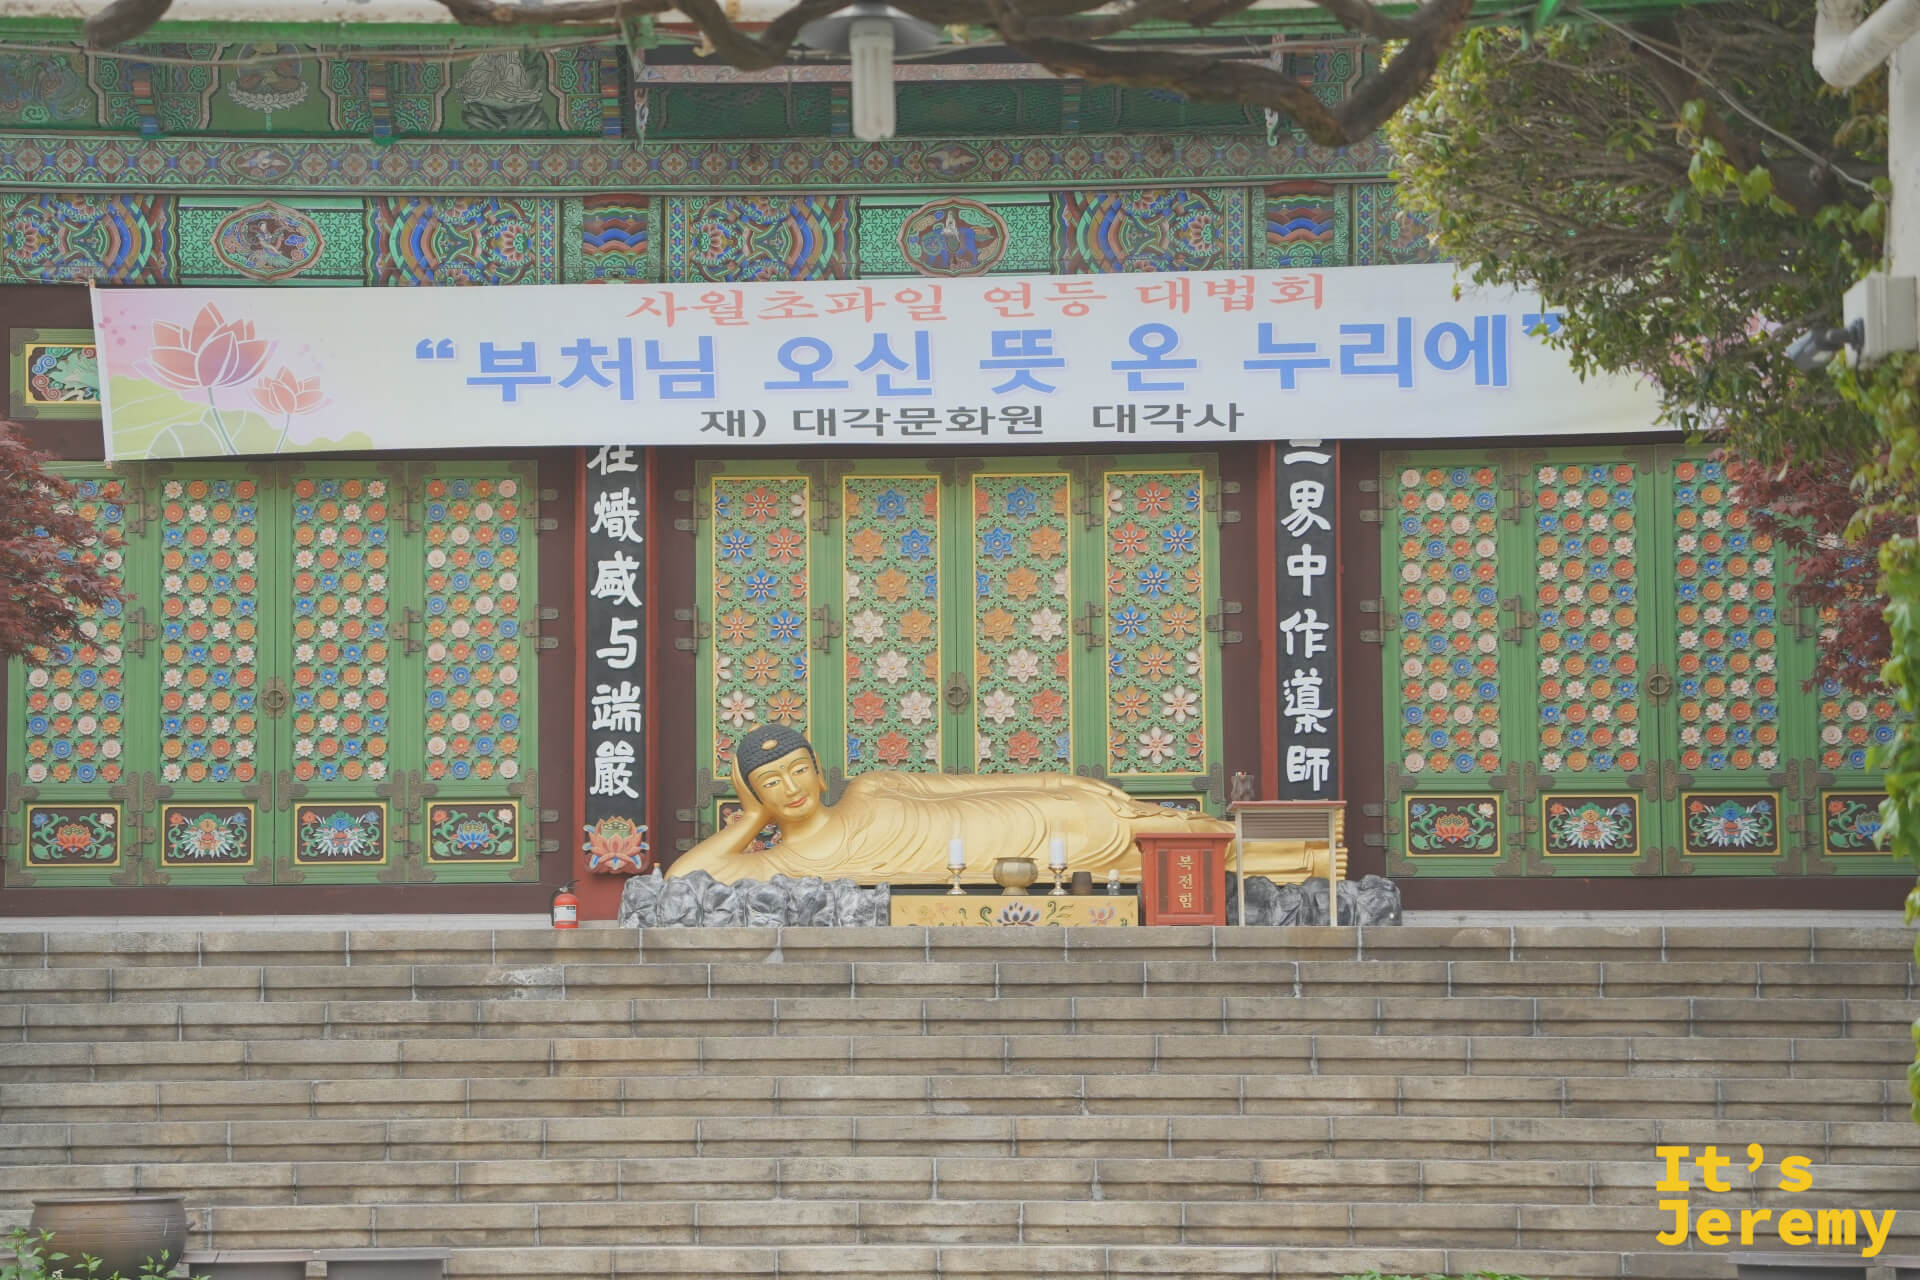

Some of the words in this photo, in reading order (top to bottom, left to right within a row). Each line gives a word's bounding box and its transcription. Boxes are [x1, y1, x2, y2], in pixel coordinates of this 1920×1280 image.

[626, 283, 948, 328] 사월초파일
[983, 281, 1108, 318] 연등
[1134, 272, 1325, 315] 대법회
[764, 330, 934, 398] 오신
[979, 328, 1066, 395] 뜻
[1110, 322, 1198, 392] 온
[699, 408, 767, 438] 재)
[792, 405, 1044, 437] 대각문화원
[1092, 402, 1246, 434] 대각사
